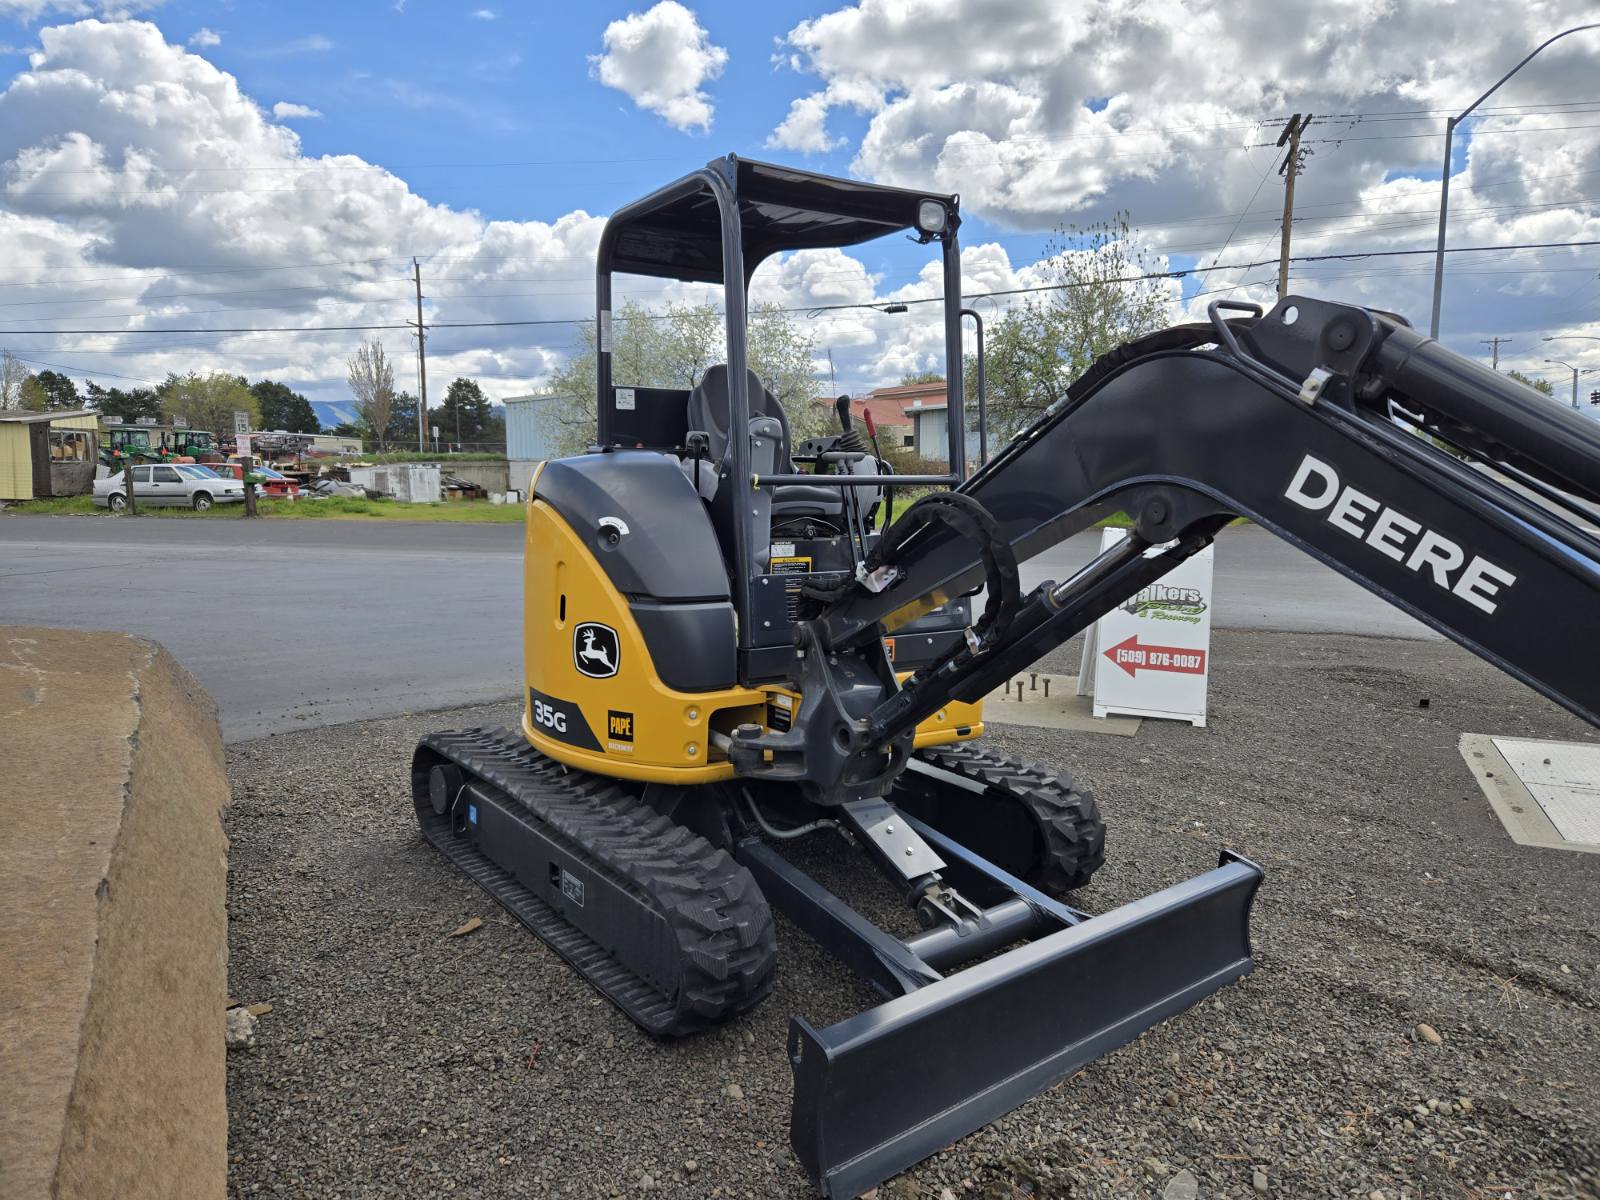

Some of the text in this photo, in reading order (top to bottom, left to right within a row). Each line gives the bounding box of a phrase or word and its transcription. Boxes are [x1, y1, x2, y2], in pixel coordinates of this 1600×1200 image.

[237, 424, 247, 432] 15
[1284, 454, 1517, 615] DEERE
[1149, 652, 1201, 668] 876-0087
[534, 699, 567, 733] 35G
